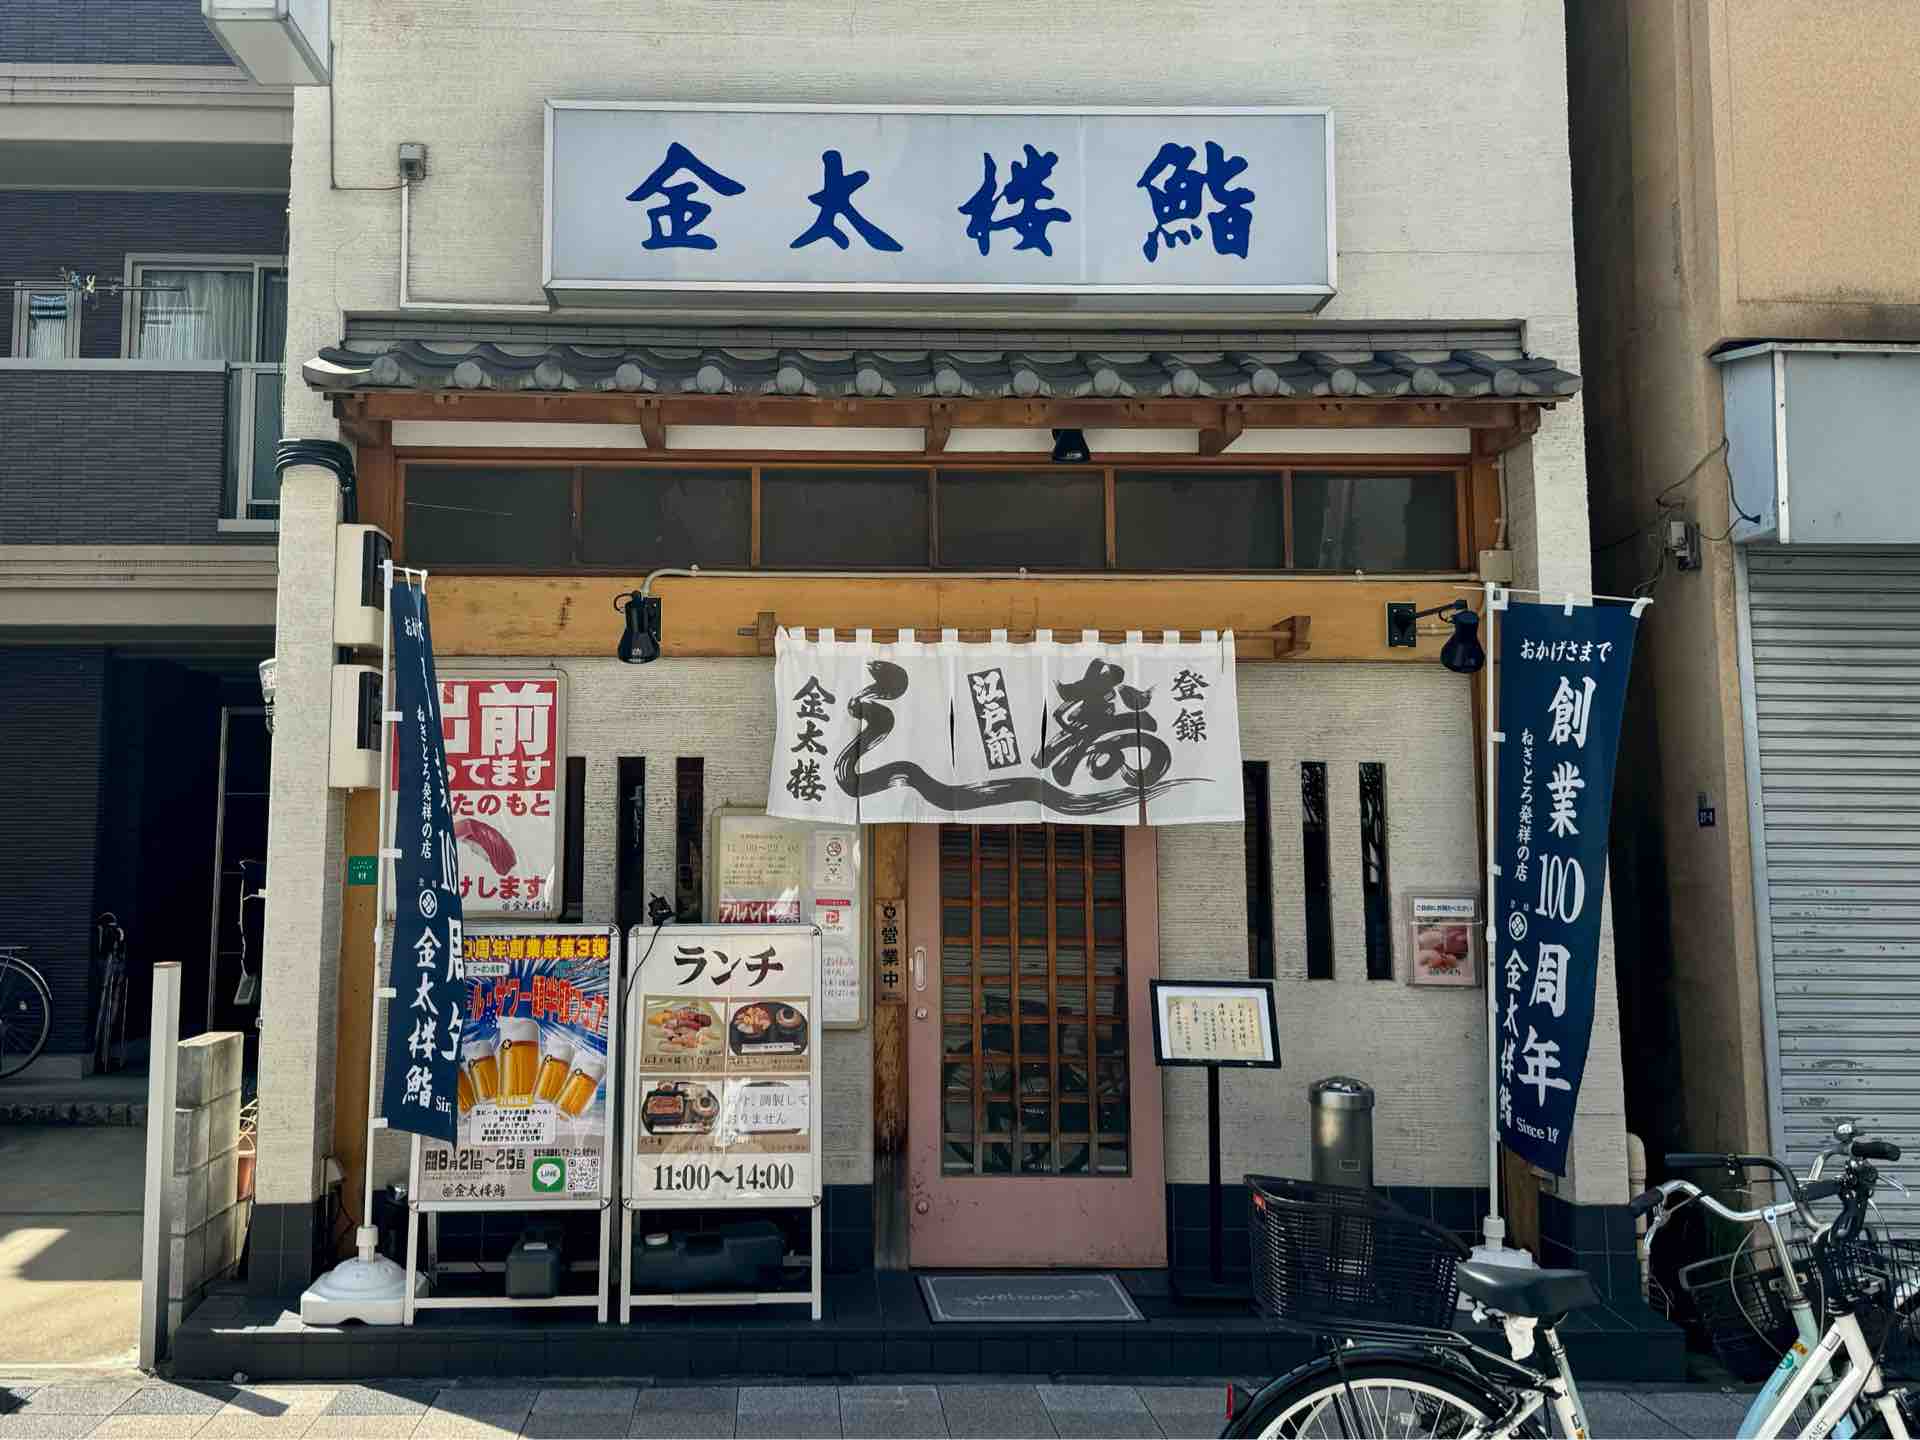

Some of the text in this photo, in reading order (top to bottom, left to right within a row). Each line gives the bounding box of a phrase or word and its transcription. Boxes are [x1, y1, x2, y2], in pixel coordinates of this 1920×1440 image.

[625, 140, 1256, 263] 金太楼鮨
[1520, 639, 1613, 662] おかげさまで
[970, 669, 1019, 768] 江戸前
[1171, 668, 1211, 744] 登録
[416, 704, 433, 859] ねぎとろ発祥の店
[1514, 728, 1534, 882] ねぎとろ発祥の店
[1517, 676, 1597, 1107] 創業100周年
[674, 944, 784, 986] ランチ
[881, 926, 898, 988] 営業中
[1516, 1116, 1545, 1140] Since
